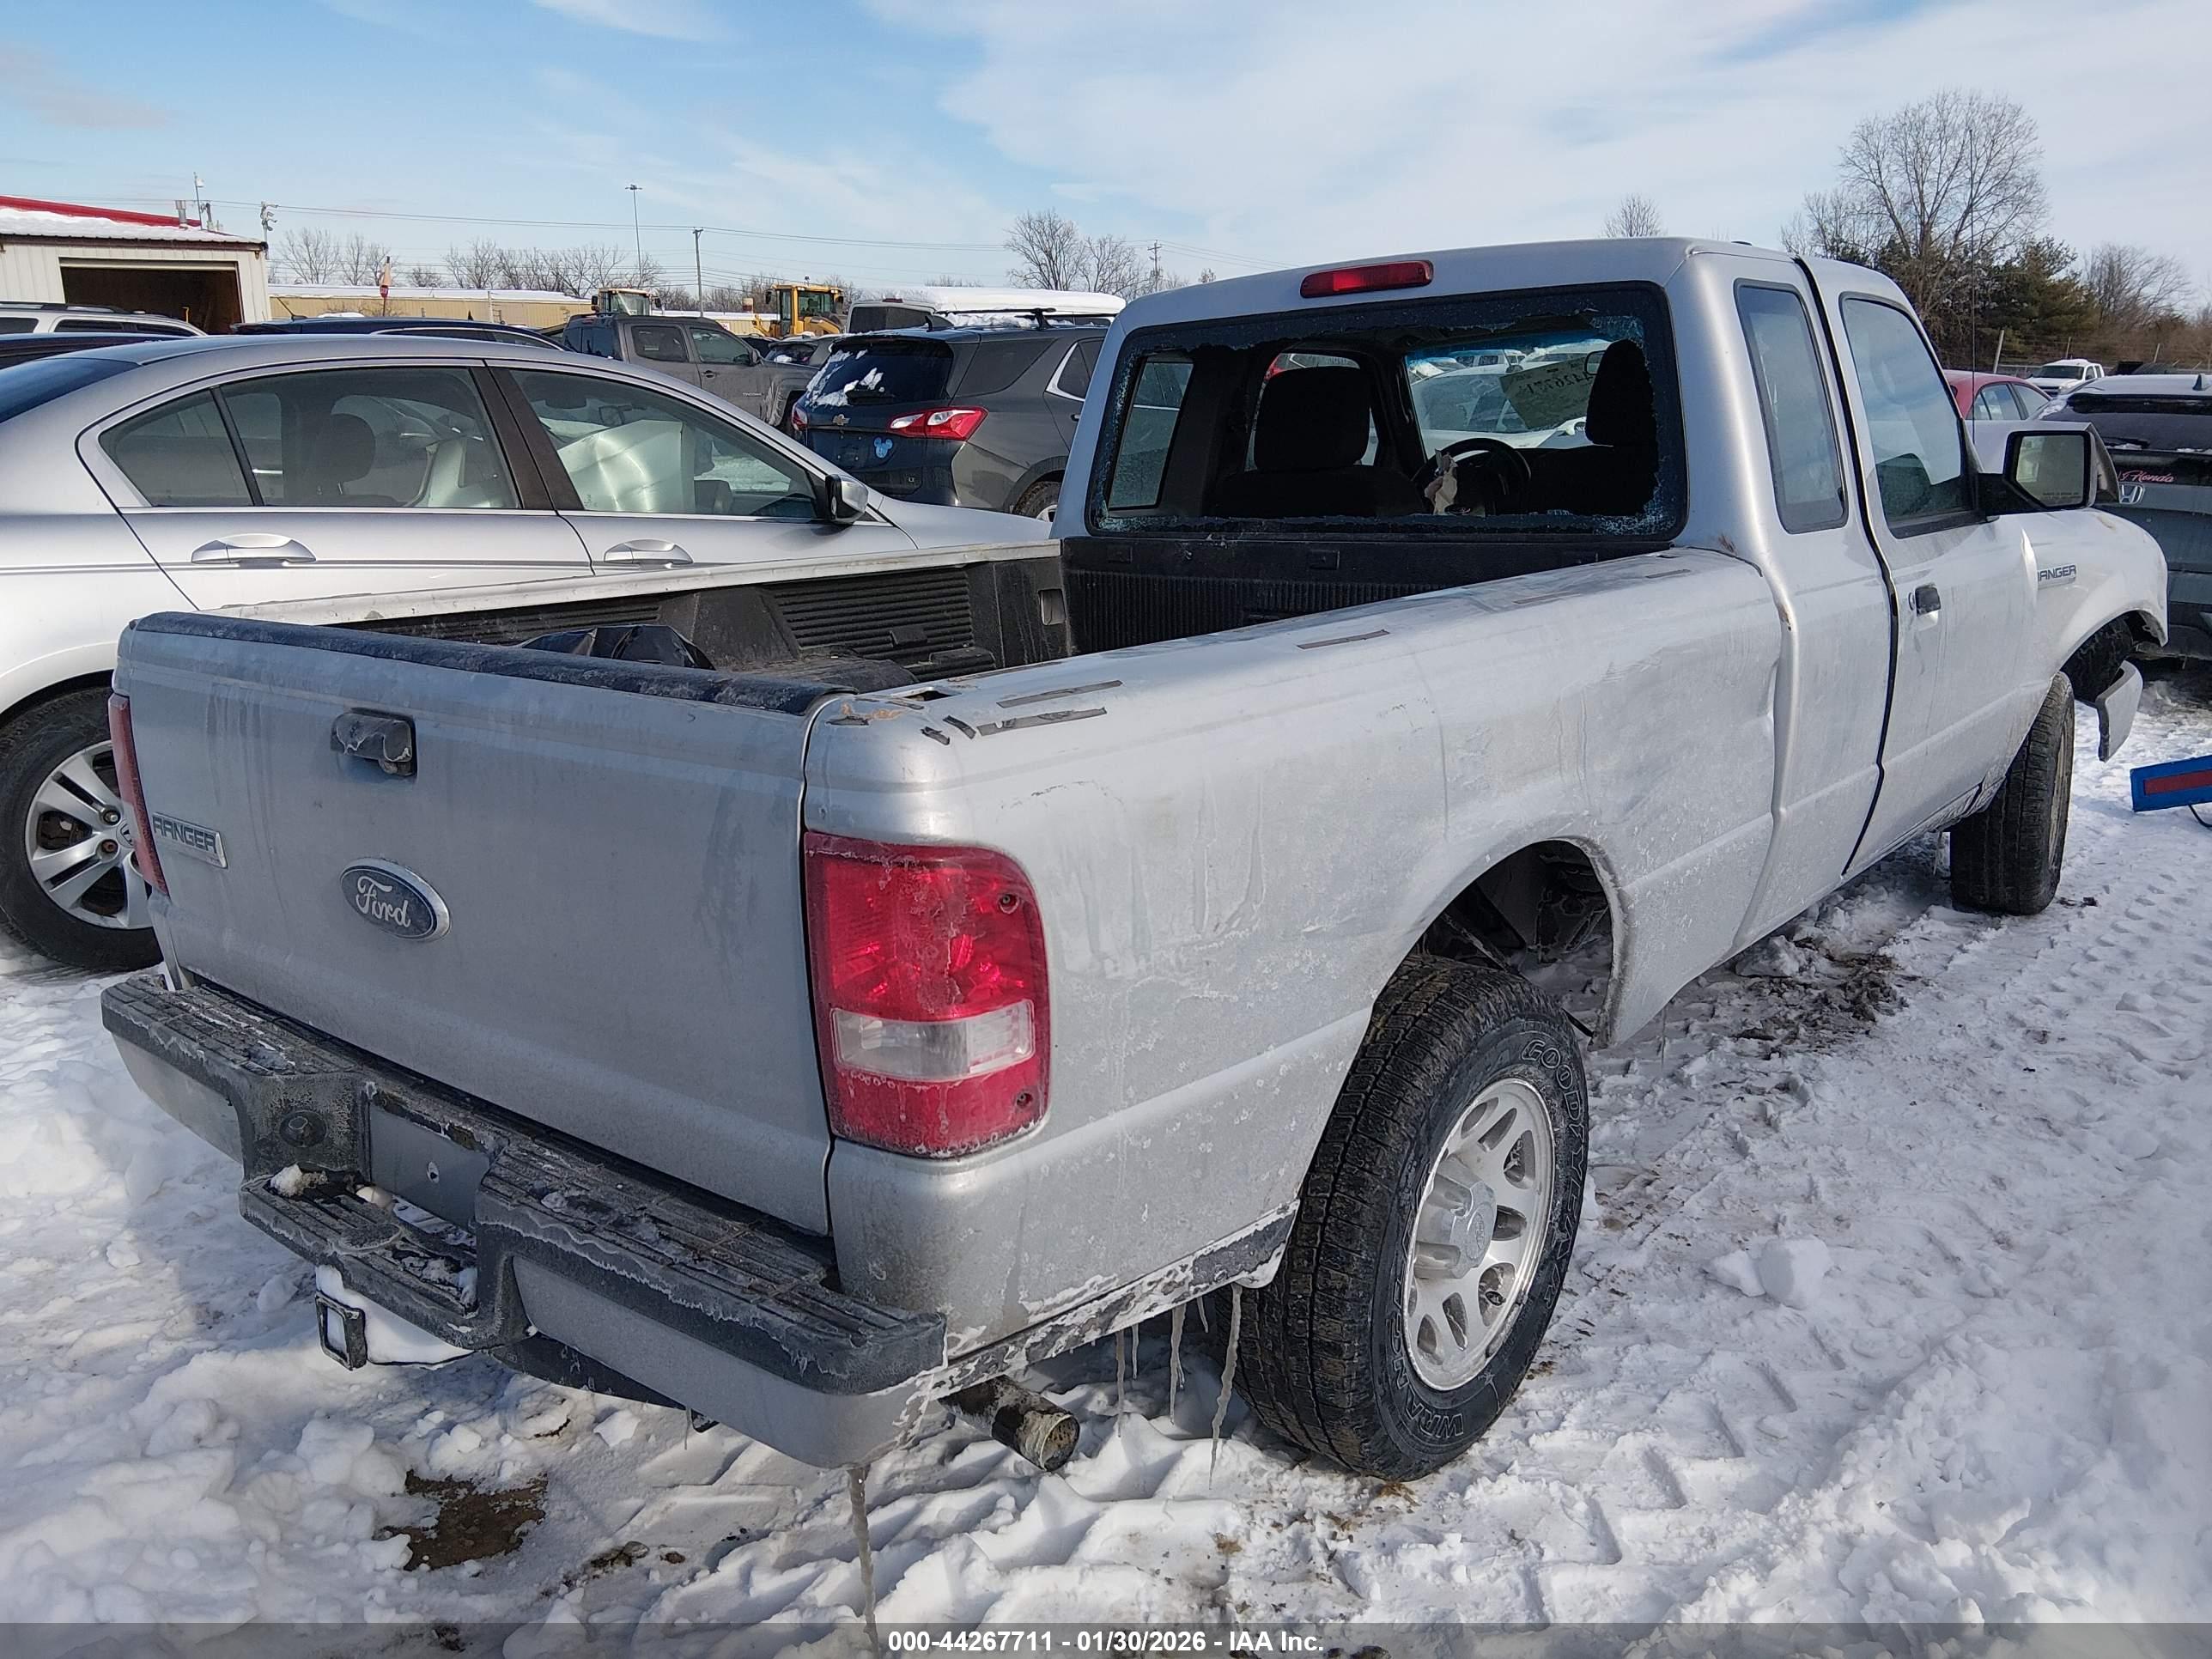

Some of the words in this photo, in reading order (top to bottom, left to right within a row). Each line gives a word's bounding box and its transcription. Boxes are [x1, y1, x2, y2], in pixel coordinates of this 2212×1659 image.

[2129, 470, 2175, 483] Honda
[152, 815, 217, 854] RANGER
[356, 875, 411, 928] Ford
[1521, 1039, 1586, 1310] GOODYEAR
